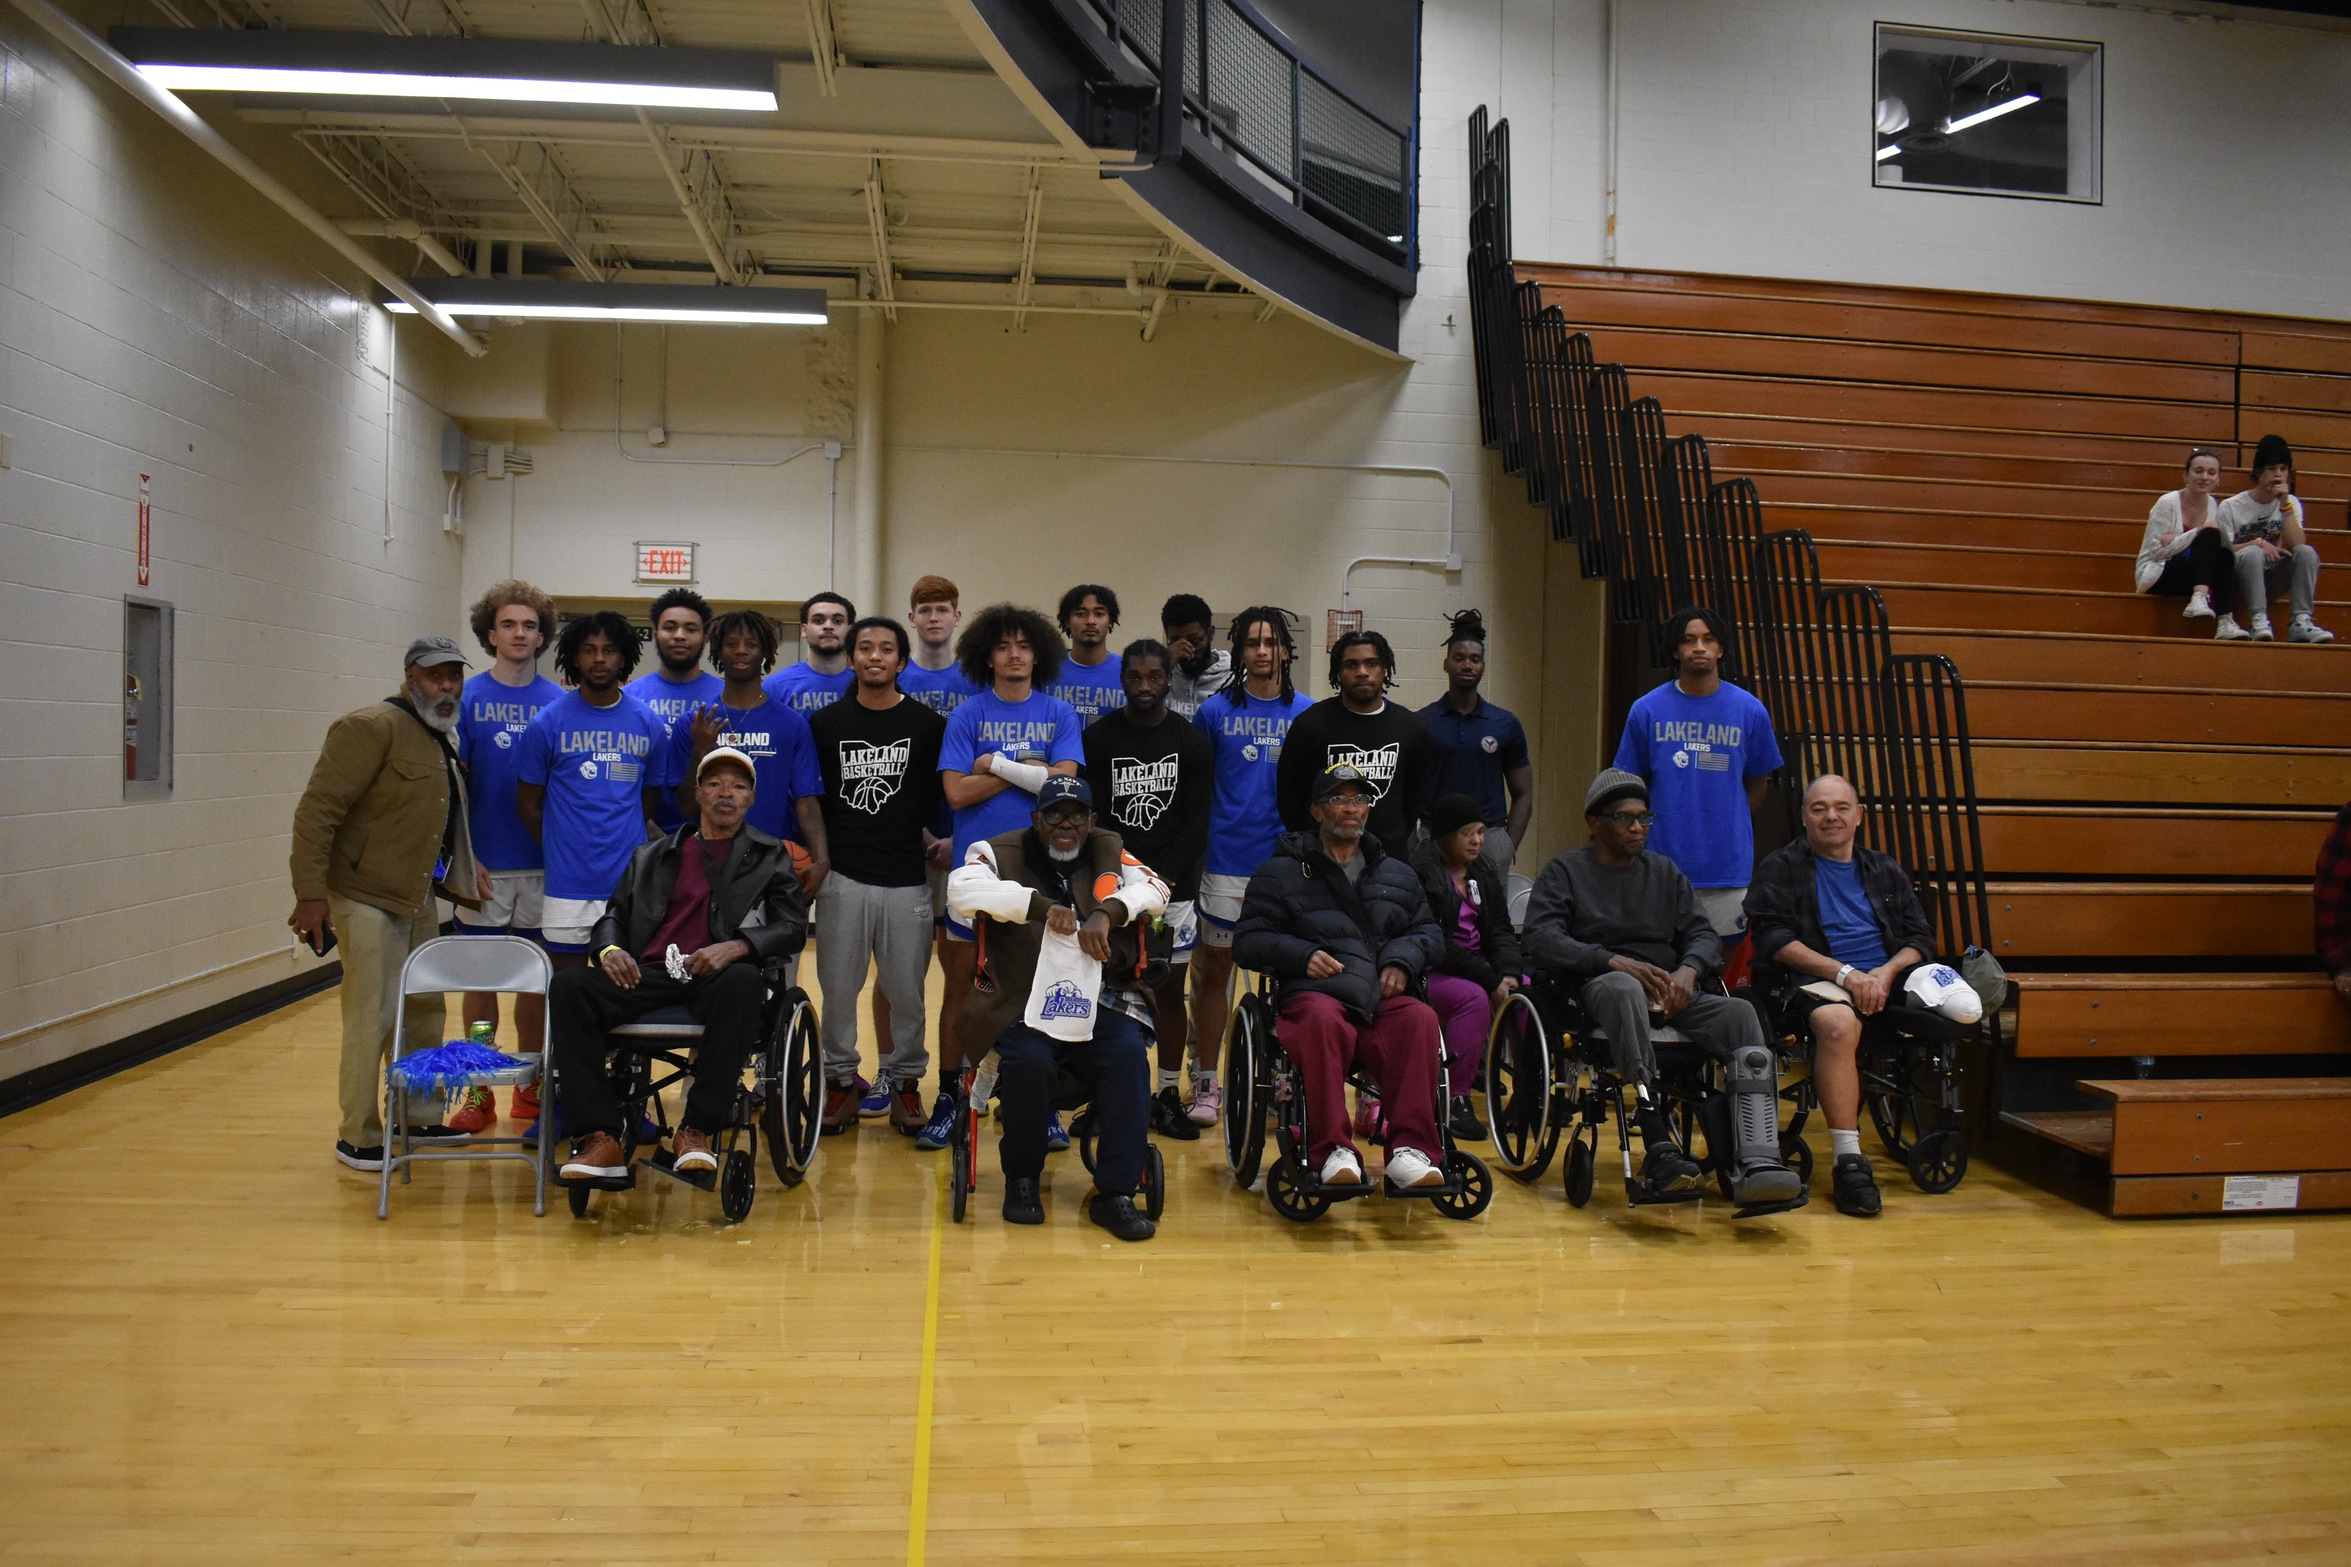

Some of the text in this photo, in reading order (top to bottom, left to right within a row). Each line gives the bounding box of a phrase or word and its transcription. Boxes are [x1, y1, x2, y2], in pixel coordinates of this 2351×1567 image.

[649, 550, 684, 574] EXIT
[641, 698, 702, 717] AKELA
[1073, 705, 1098, 714] AKERS
[978, 720, 1056, 743] LAKELAND
[1253, 736, 1280, 746] LAKERS
[1655, 721, 1741, 747] LAKELAND
[561, 730, 650, 757] LAKELAND
[1002, 741, 1030, 751] LAKERS
[1683, 742, 1711, 752] LAKERS
[592, 752, 622, 762] LAKERS
[841, 746, 908, 767] LAKELAND
[1328, 750, 1397, 768] LAKELAND
[842, 762, 903, 780] BASKETBALL
[1113, 762, 1176, 783] LAKELAND
[1114, 778, 1174, 797] BASKETBALL
[1040, 995, 1090, 1018] Lakers
